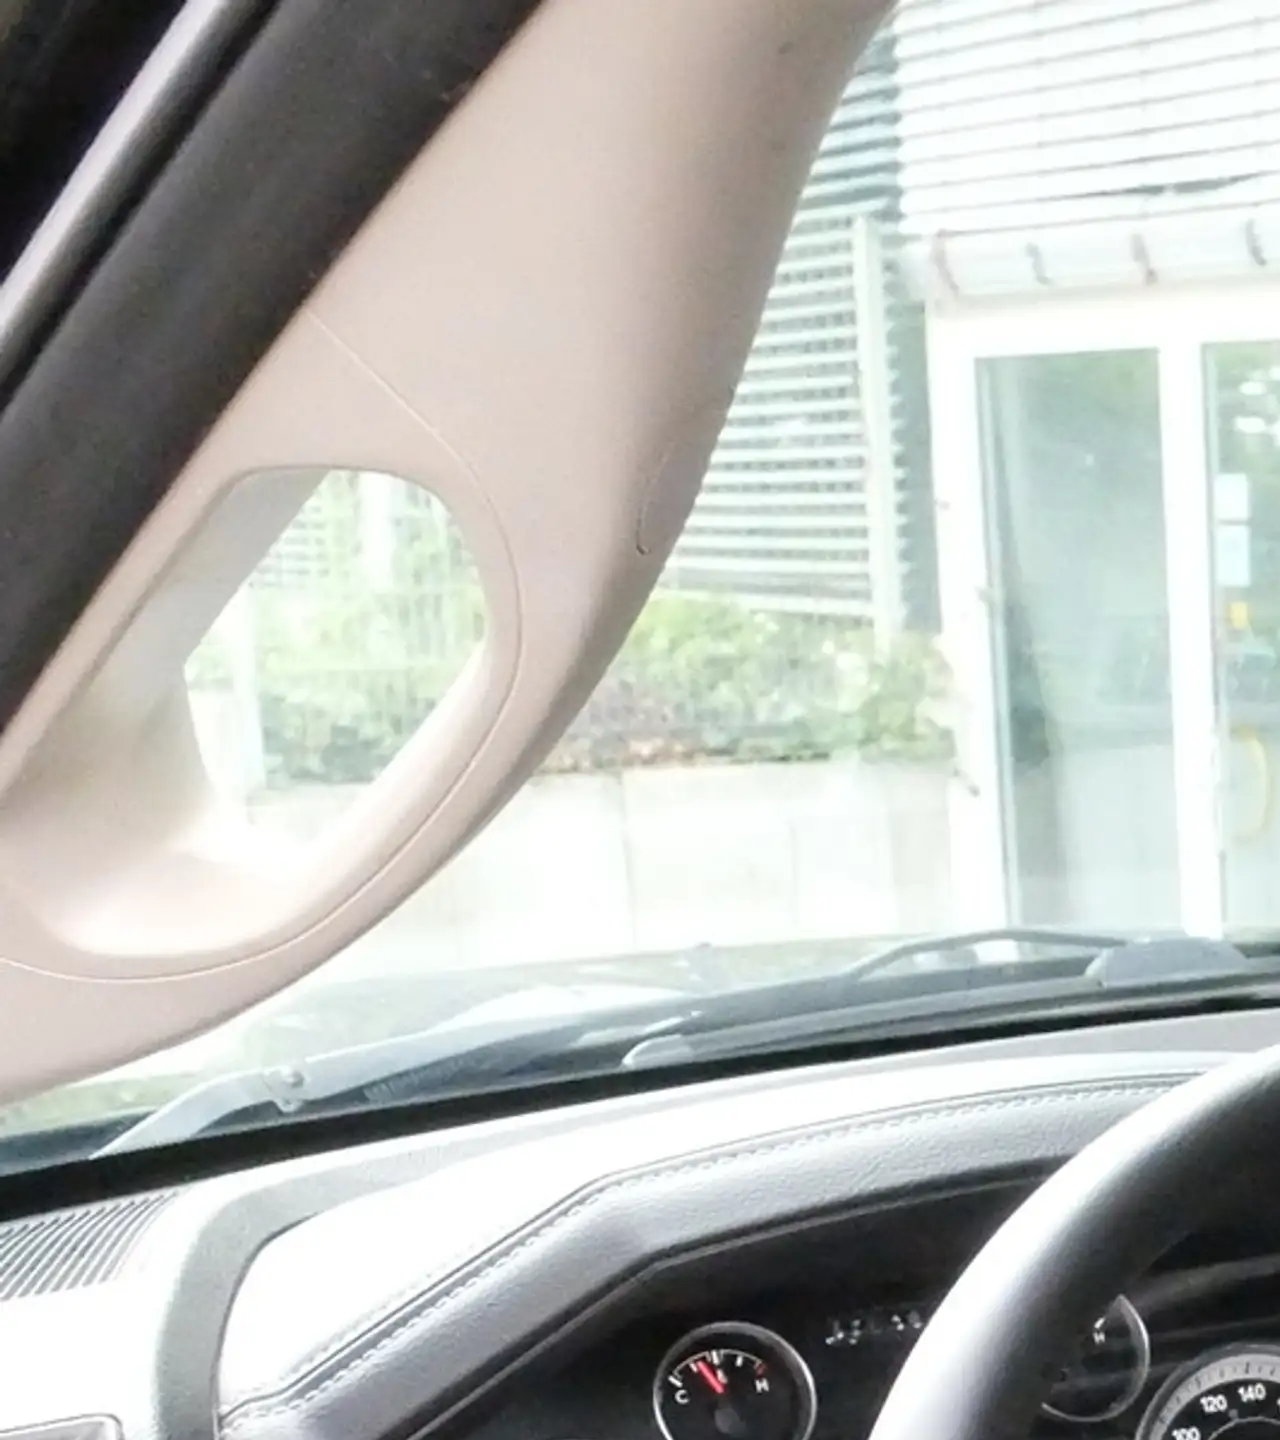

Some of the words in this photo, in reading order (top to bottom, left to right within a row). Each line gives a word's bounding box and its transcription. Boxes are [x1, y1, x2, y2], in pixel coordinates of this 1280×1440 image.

[755, 1380, 769, 1393] H
[1238, 1383, 1266, 1402] 140
[674, 1389, 689, 1404] C
[1201, 1394, 1228, 1413] 120
